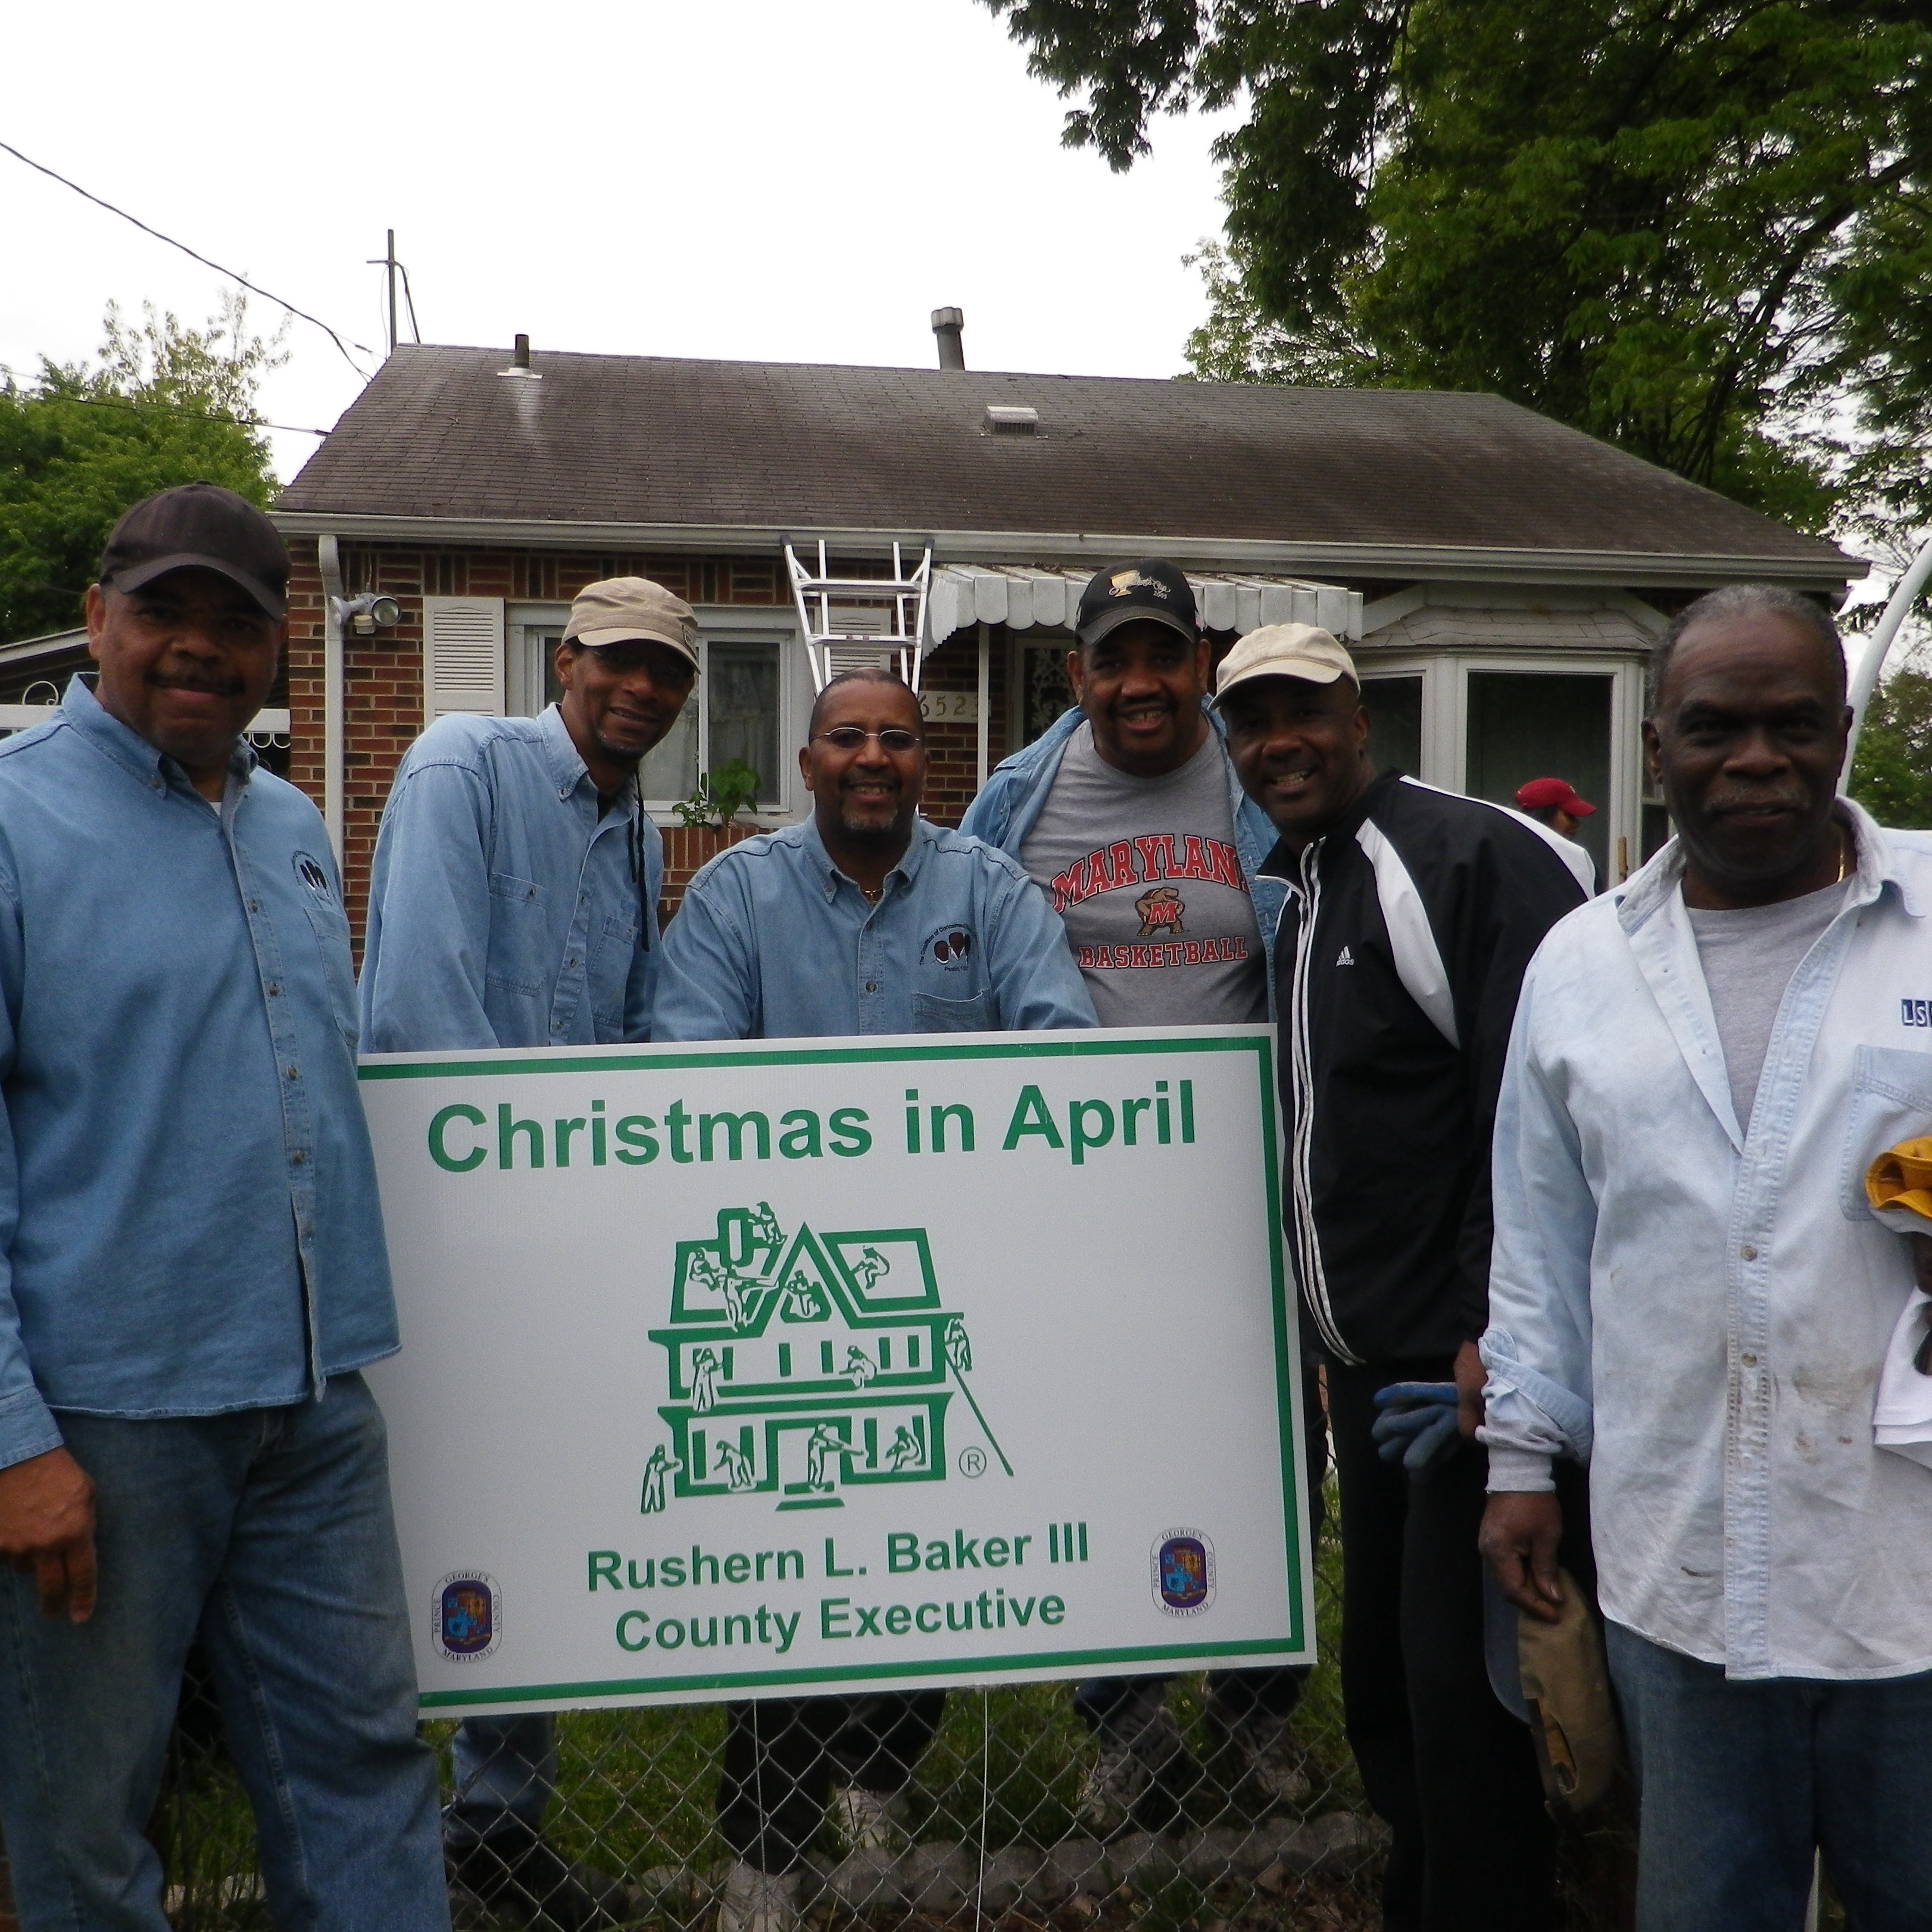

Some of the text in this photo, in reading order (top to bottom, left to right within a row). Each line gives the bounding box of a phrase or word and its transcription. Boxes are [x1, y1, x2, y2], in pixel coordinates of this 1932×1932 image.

[919, 694, 978, 717] 652
[1051, 834, 1250, 914] MARYLAN
[1079, 937, 1249, 968] BASKETBALL
[1902, 1000, 1932, 1026] LS
[427, 1079, 1195, 1172] Christmas in April
[588, 1522, 1088, 1591] Rushern L. Baker III
[616, 1588, 1065, 1653] County Executive
